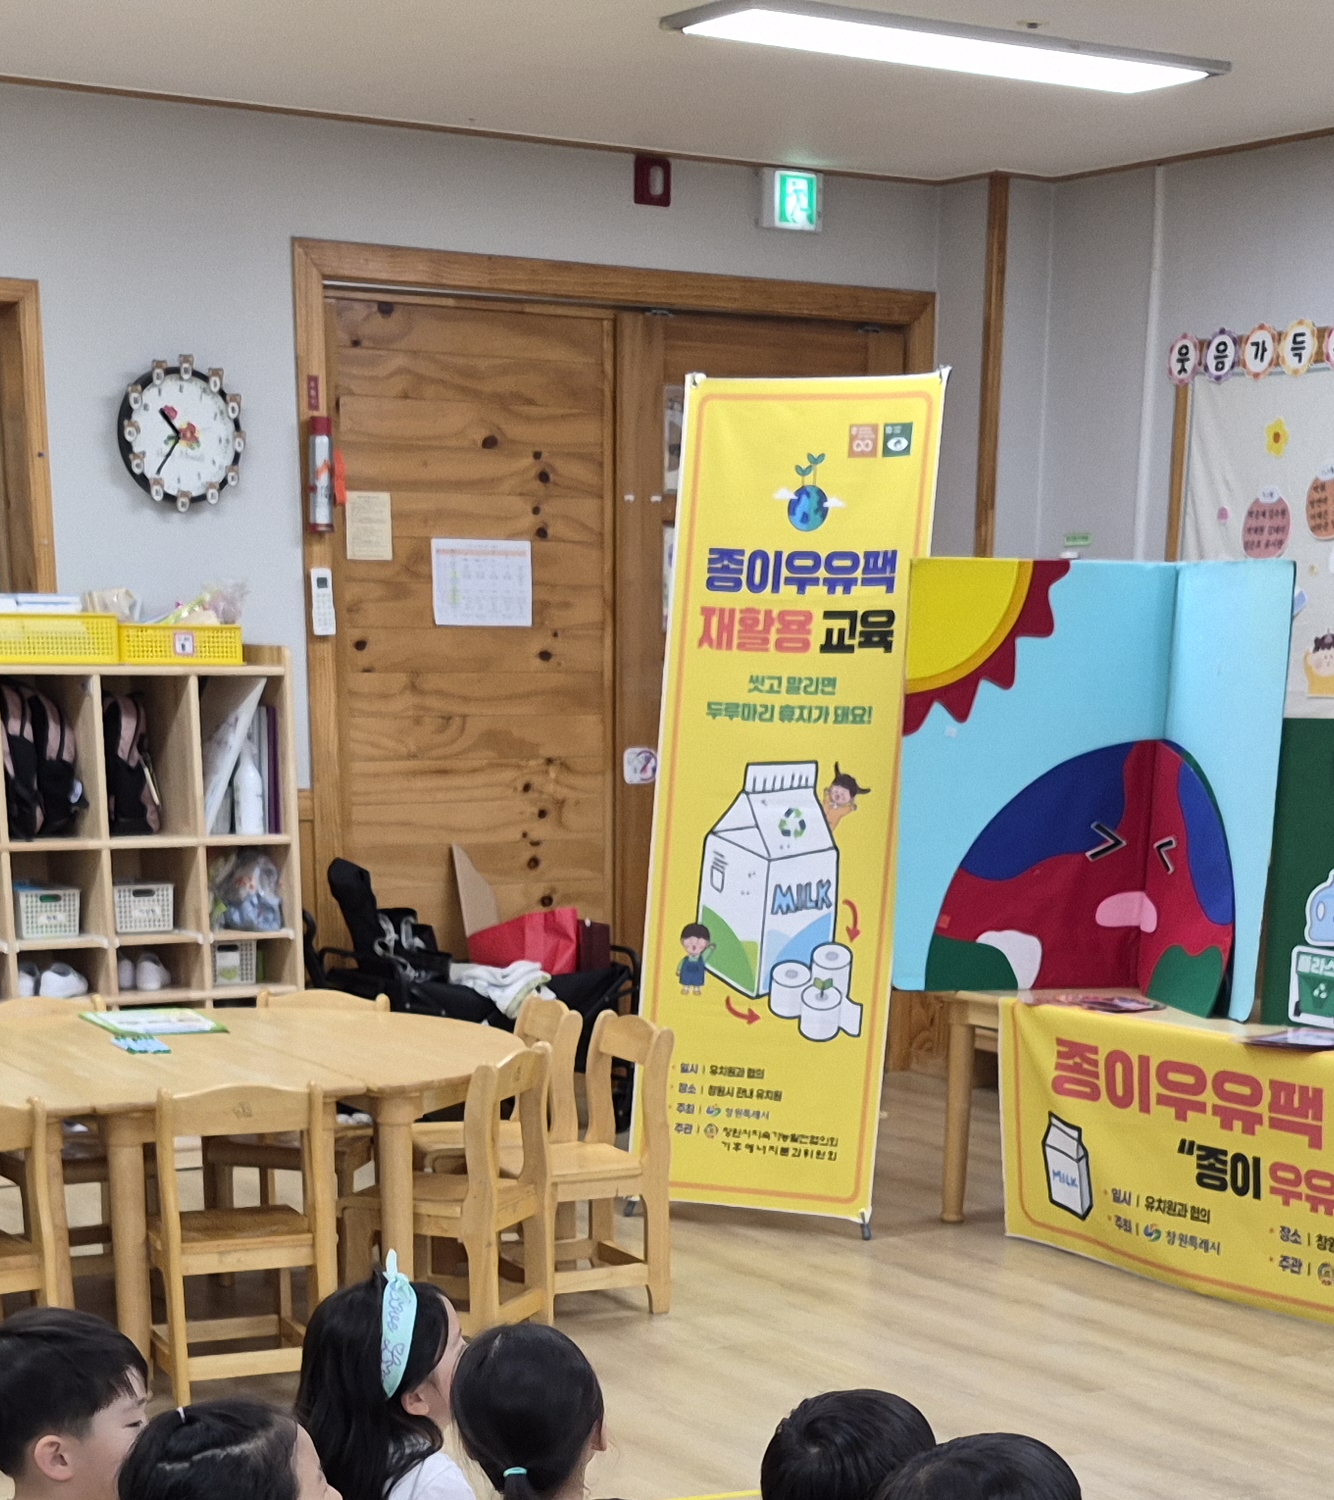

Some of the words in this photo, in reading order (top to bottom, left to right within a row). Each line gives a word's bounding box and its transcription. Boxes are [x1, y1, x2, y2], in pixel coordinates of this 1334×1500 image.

[705, 547, 898, 595] 종이우유팩
[697, 606, 814, 654] 재활용
[819, 609, 896, 654] 교육
[747, 674, 783, 695] 씻고
[785, 675, 838, 696] 말리면
[705, 700, 776, 723] 두루마리
[778, 703, 830, 725] 휴지가
[770, 879, 833, 916] MILK
[1049, 1036, 1325, 1150] 종이우유팩
[1111, 1187, 1132, 1207] 일시
[1144, 1195, 1189, 1219] 유치원과
[1189, 1204, 1211, 1224] 협의
[1279, 1225, 1303, 1245] 장소
[1278, 1254, 1303, 1276] 주관
